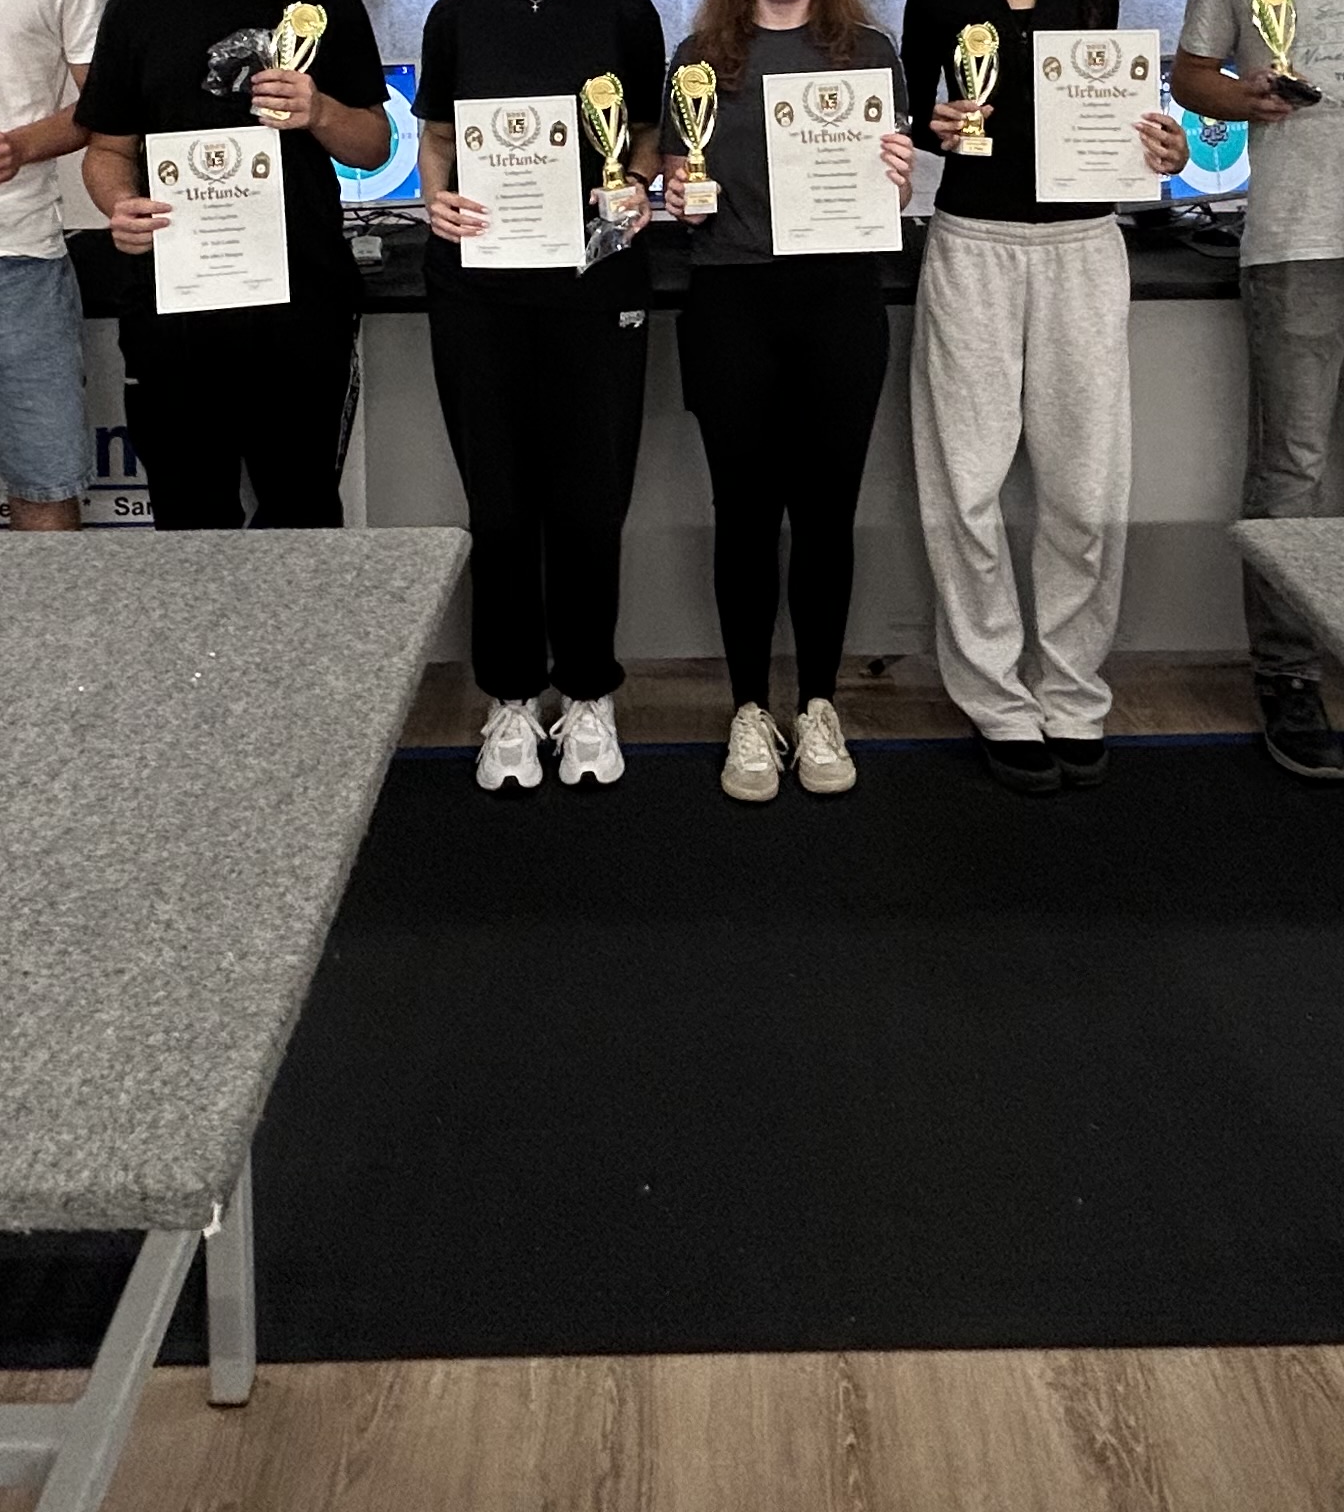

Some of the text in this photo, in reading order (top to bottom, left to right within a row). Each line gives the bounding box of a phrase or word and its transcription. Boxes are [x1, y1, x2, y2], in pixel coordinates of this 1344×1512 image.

[1067, 85, 1128, 99] Urkunde
[801, 129, 862, 144] Urkunde
[489, 153, 548, 168] Urkunde
[186, 186, 250, 201] Urkunde
